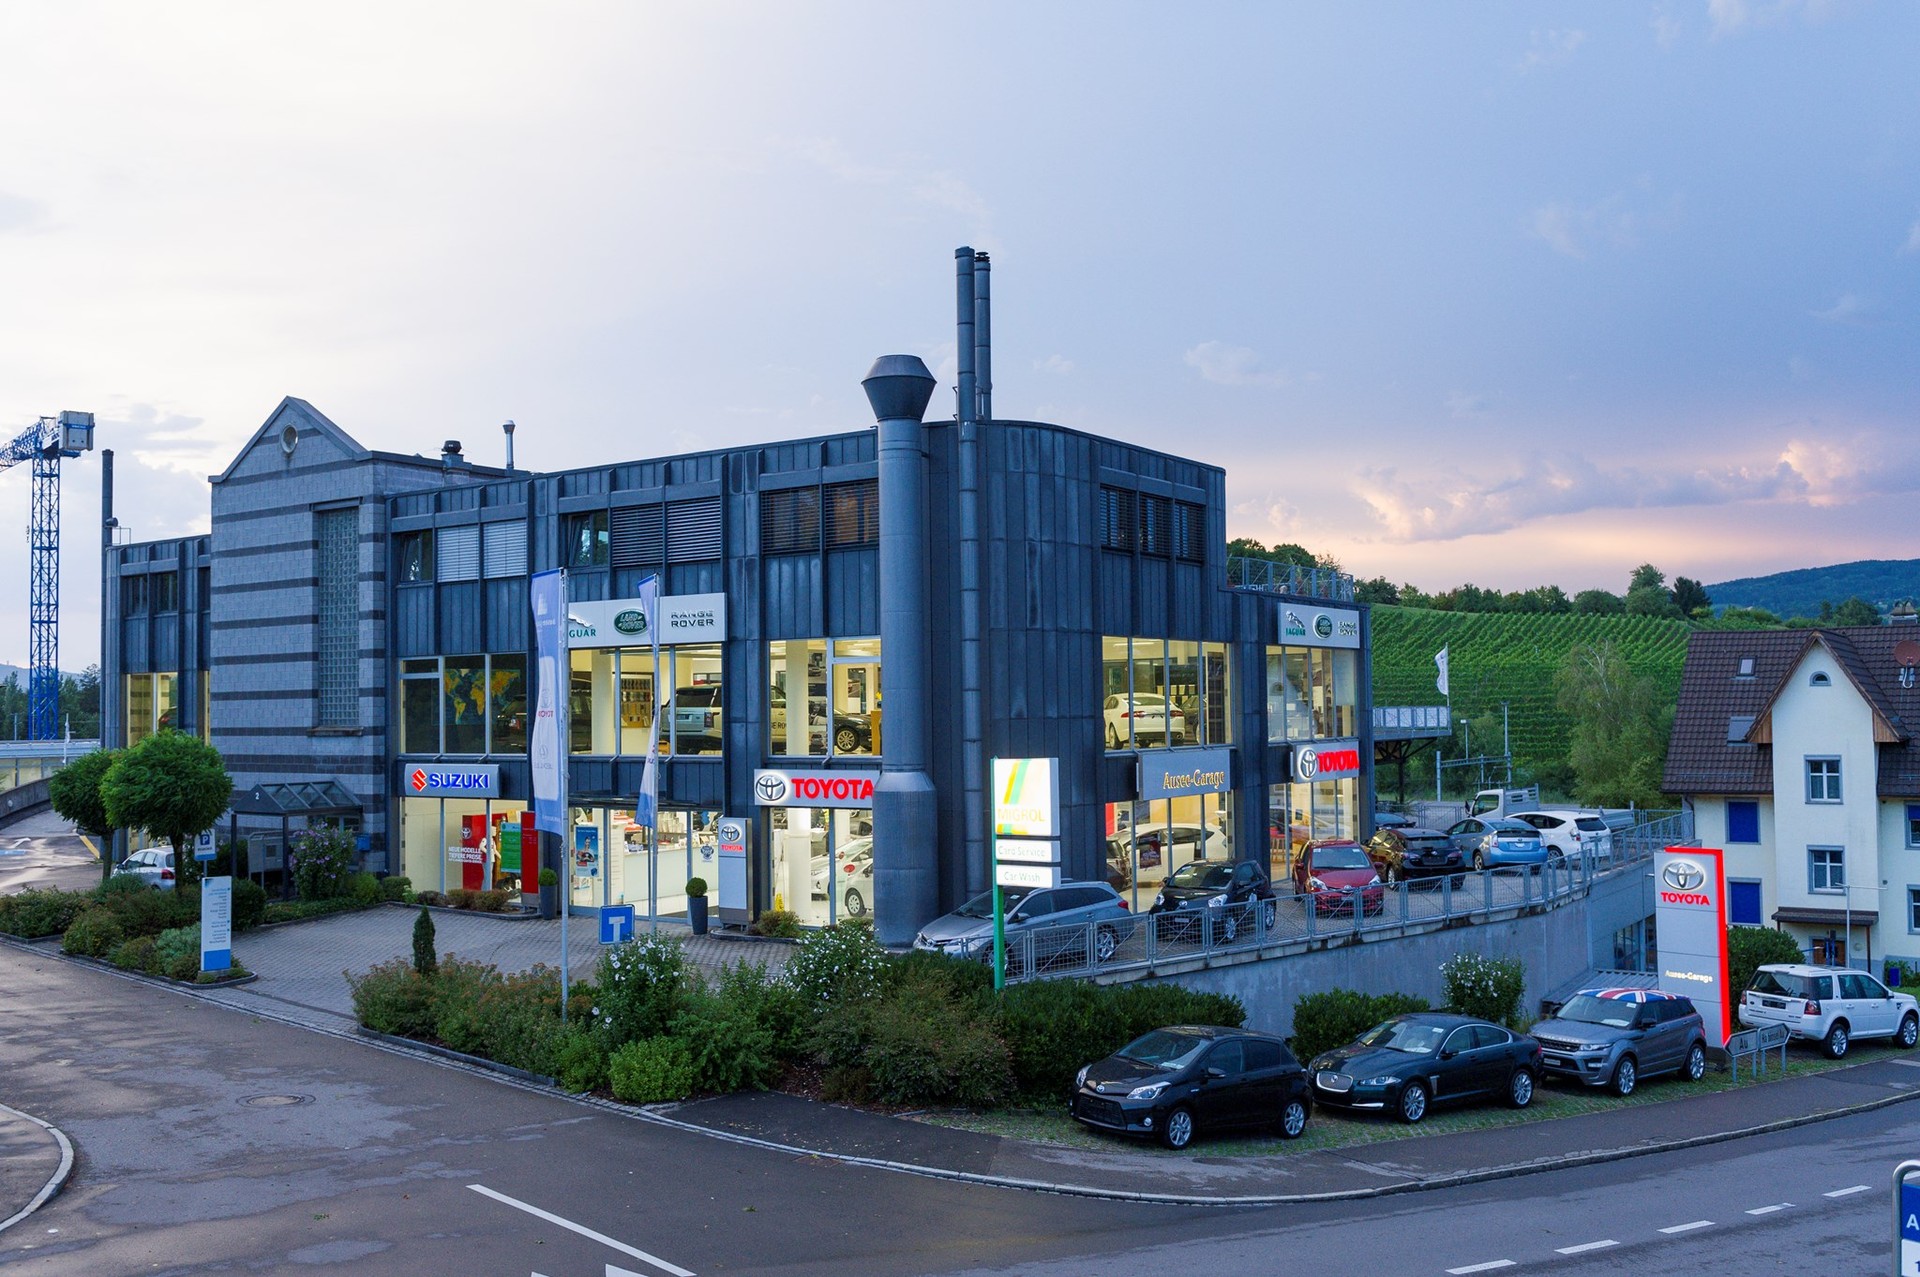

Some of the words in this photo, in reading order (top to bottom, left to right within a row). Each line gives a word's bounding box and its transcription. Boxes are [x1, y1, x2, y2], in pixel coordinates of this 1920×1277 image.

[671, 619, 714, 628] ROVER
[569, 628, 597, 638] GUAR
[1286, 627, 1306, 636] JAGUAR
[1317, 750, 1359, 773] TOYOTA
[429, 773, 490, 789] SUZUKI
[1163, 769, 1224, 790] Ausee-Garage
[791, 778, 873, 800] TOYOTA
[255, 792, 260, 800] 2
[998, 808, 1046, 822] MIGROL
[1017, 846, 1046, 857] Service
[1004, 871, 1017, 881] Car
[1019, 872, 1041, 883] Wash
[1660, 892, 1710, 905] TOYOTA
